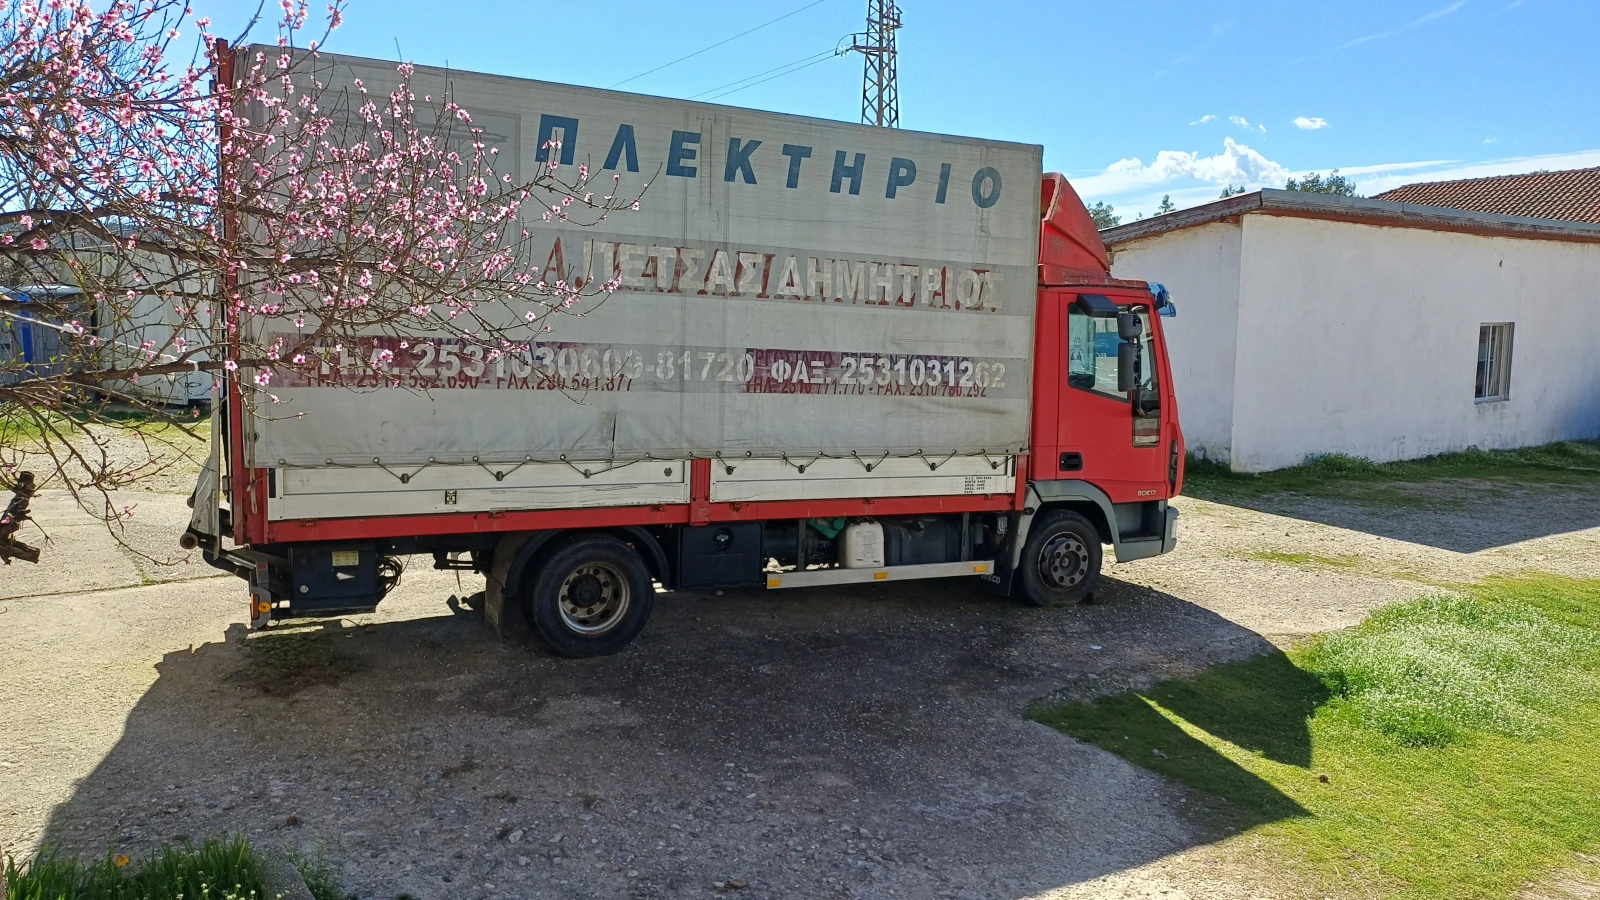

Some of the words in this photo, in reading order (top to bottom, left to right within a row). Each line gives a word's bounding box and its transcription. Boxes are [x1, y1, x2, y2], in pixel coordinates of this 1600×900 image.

[535, 114, 1003, 209] ΠΛΕΚΤΗΡΙΟ
[776, 255, 1005, 309] ΔΗΜΗΤΡΙΟΣ
[839, 356, 1006, 389] 2531031262
